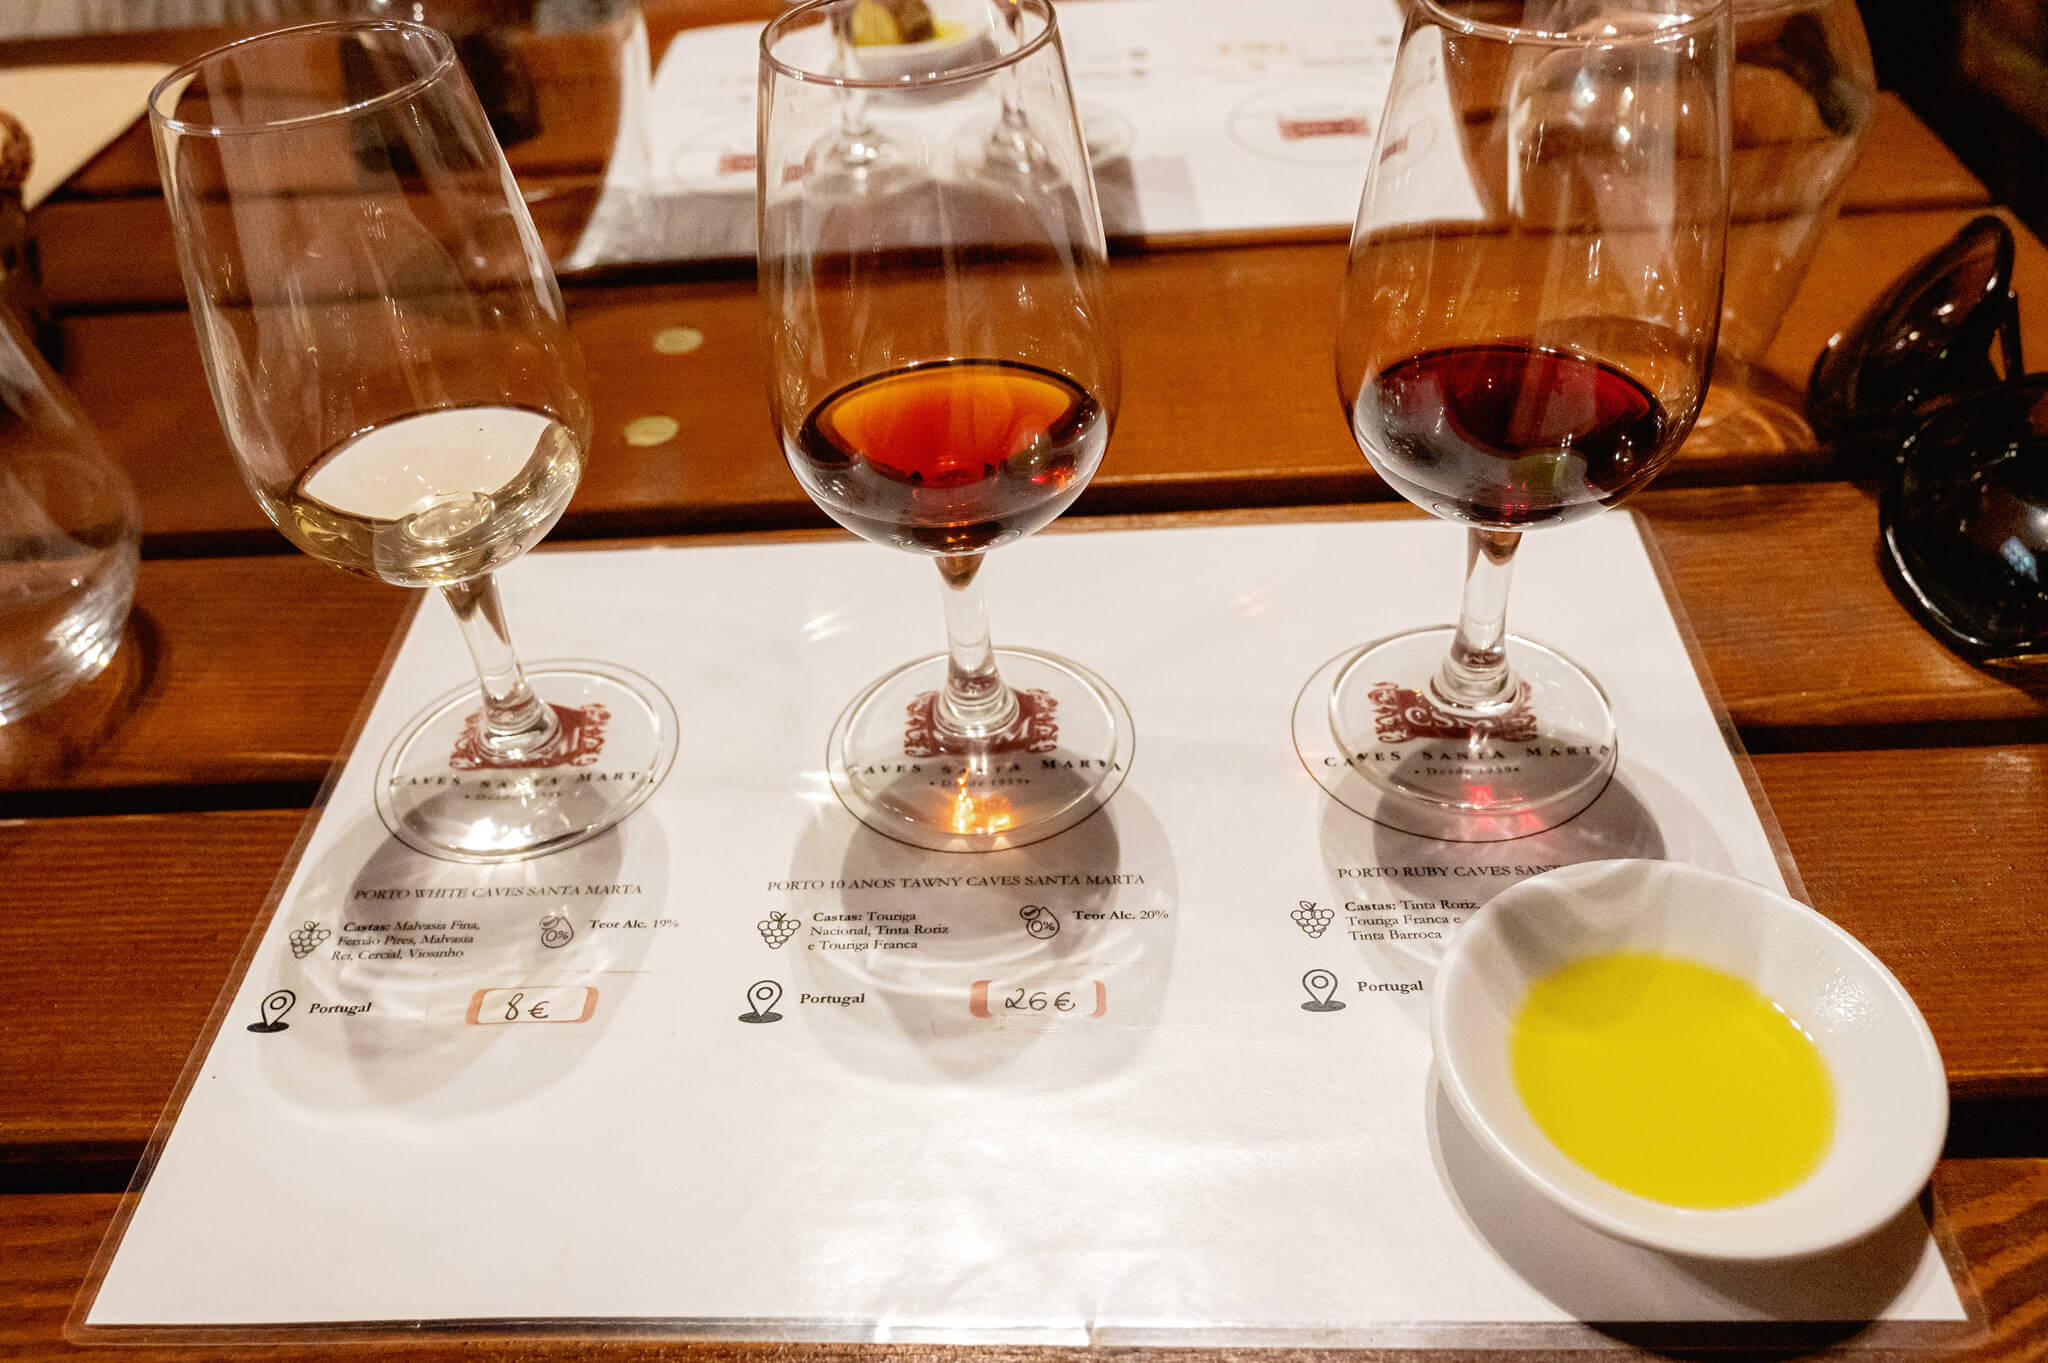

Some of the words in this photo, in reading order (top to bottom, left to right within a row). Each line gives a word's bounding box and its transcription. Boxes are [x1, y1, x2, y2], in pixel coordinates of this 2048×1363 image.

[1338, 867, 1398, 878] PORTO
[1403, 866, 1449, 877] RUBY
[1454, 865, 1511, 877] CAVES
[768, 880, 824, 891] PORTO
[830, 879, 845, 889] 10
[848, 878, 895, 889] ANOS
[899, 877, 962, 888] TAWNY
[966, 875, 1020, 886] CAVES
[1024, 875, 1080, 886] SANTA
[1086, 874, 1145, 885] MARTA
[355, 888, 410, 900] PORTO
[415, 887, 468, 898] WHITE
[472, 886, 524, 897] CAVES
[527, 885, 580, 896] SANTA
[584, 884, 642, 895] MARTA
[1344, 901, 1396, 912] Castas:
[1399, 900, 1436, 911] Tinta
[813, 912, 862, 922] Castas:
[866, 911, 916, 923] Touriga
[1072, 910, 1106, 921] Teor
[1109, 910, 1135, 920] Alc.
[1140, 910, 1169, 920] 20%
[1347, 915, 1399, 928] Touriga
[1403, 914, 1450, 925] Franca
[1453, 917, 1462, 925] e
[343, 921, 389, 932] Castas:
[394, 920, 446, 931] Malvasia
[450, 919, 480, 931] Fina,
[589, 919, 620, 929] Teor
[622, 919, 647, 929] Alc.
[653, 918, 680, 928] 19%
[809, 925, 871, 937] Nacional,
[876, 925, 909, 935] Tinta
[914, 924, 948, 934] Roriz
[1348, 930, 1385, 941] Tinta
[1389, 929, 1442, 940] Barroca
[384, 935, 416, 946] Pires,
[420, 934, 474, 944] Malvasia
[807, 943, 815, 951] e
[819, 940, 869, 952] Touriga
[409, 947, 464, 958] Viosinho
[1357, 980, 1424, 994] Portugal
[800, 993, 865, 1007] Portugal
[309, 1002, 372, 1016] Portugal
